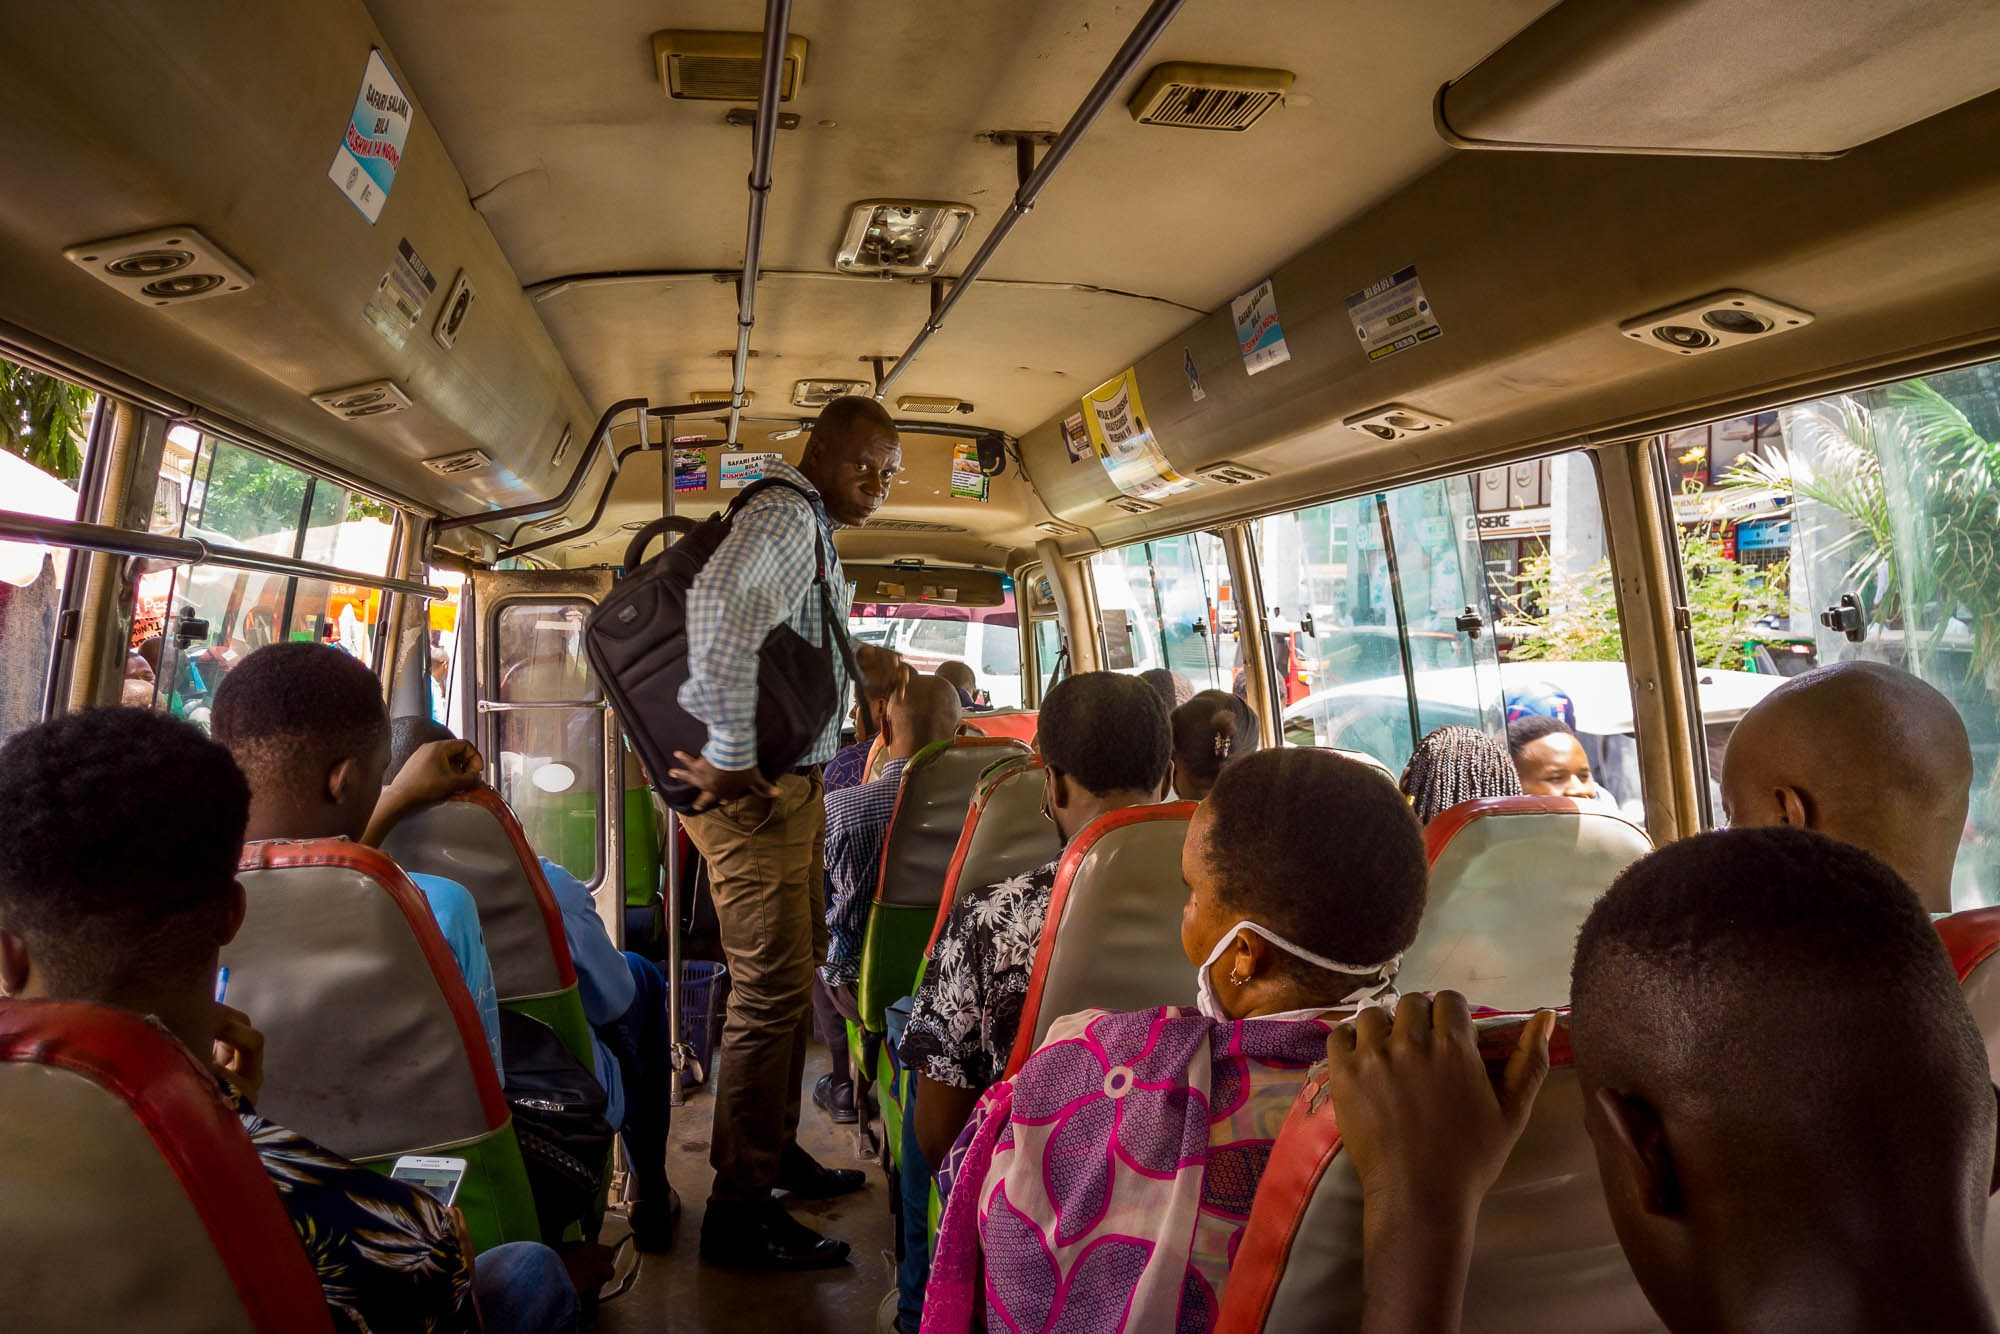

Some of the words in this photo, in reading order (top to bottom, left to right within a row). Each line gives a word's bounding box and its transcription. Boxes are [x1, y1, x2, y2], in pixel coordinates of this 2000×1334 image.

[366, 84, 388, 112] SAFARI
[388, 95, 409, 121] SALAMA
[374, 117, 389, 135] BILA
[346, 122, 373, 158] RUSHWA
[728, 457, 749, 467] SAFARI
[745, 462, 759, 470] BILA
[722, 471, 748, 480] RUSHWA
